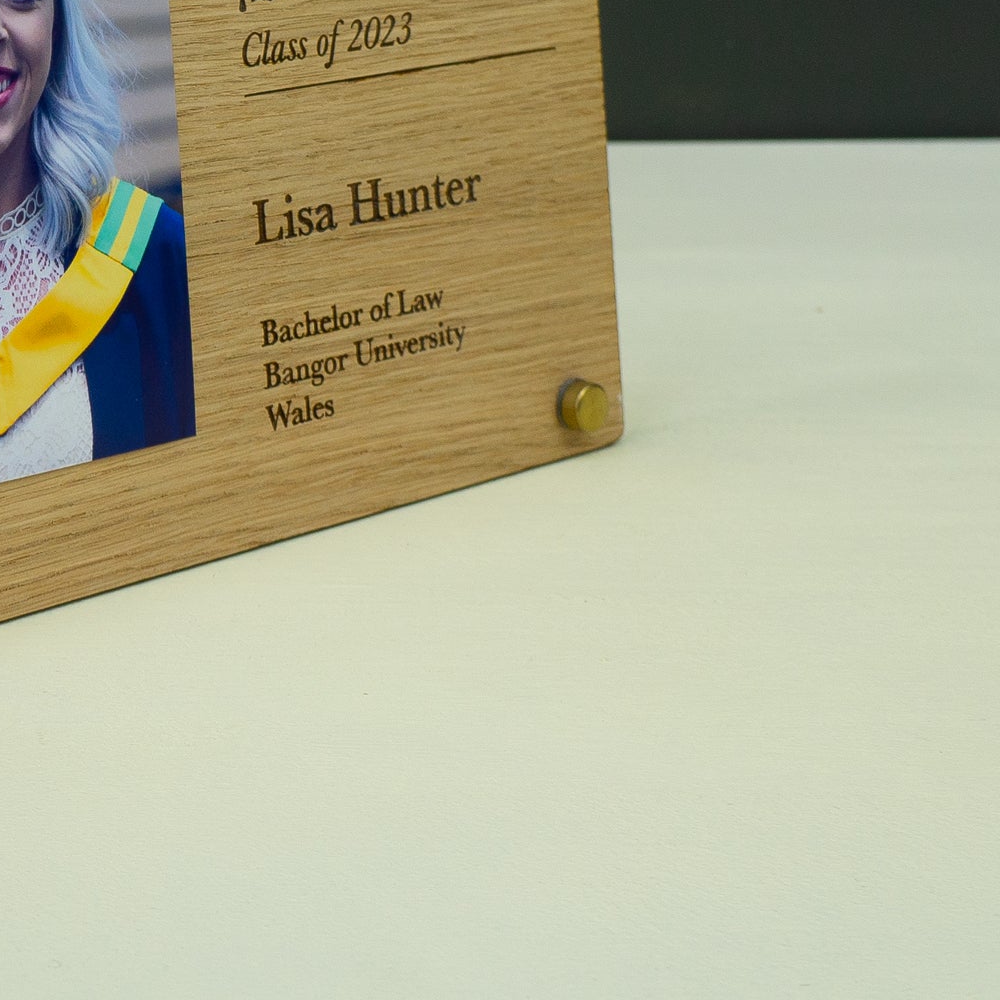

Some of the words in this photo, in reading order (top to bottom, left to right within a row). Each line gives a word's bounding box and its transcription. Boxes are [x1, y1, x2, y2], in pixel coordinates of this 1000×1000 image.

[241, 31, 308, 68] Class
[316, 18, 345, 69] of
[346, 11, 413, 53] 2023
[251, 193, 338, 246] Lisa
[346, 173, 482, 227] Hunter
[259, 303, 364, 348] Bachelor
[369, 292, 394, 322] of
[395, 288, 444, 317] Law
[263, 352, 349, 390] Bangor
[353, 321, 467, 367] University
[265, 395, 335, 432] Wales
